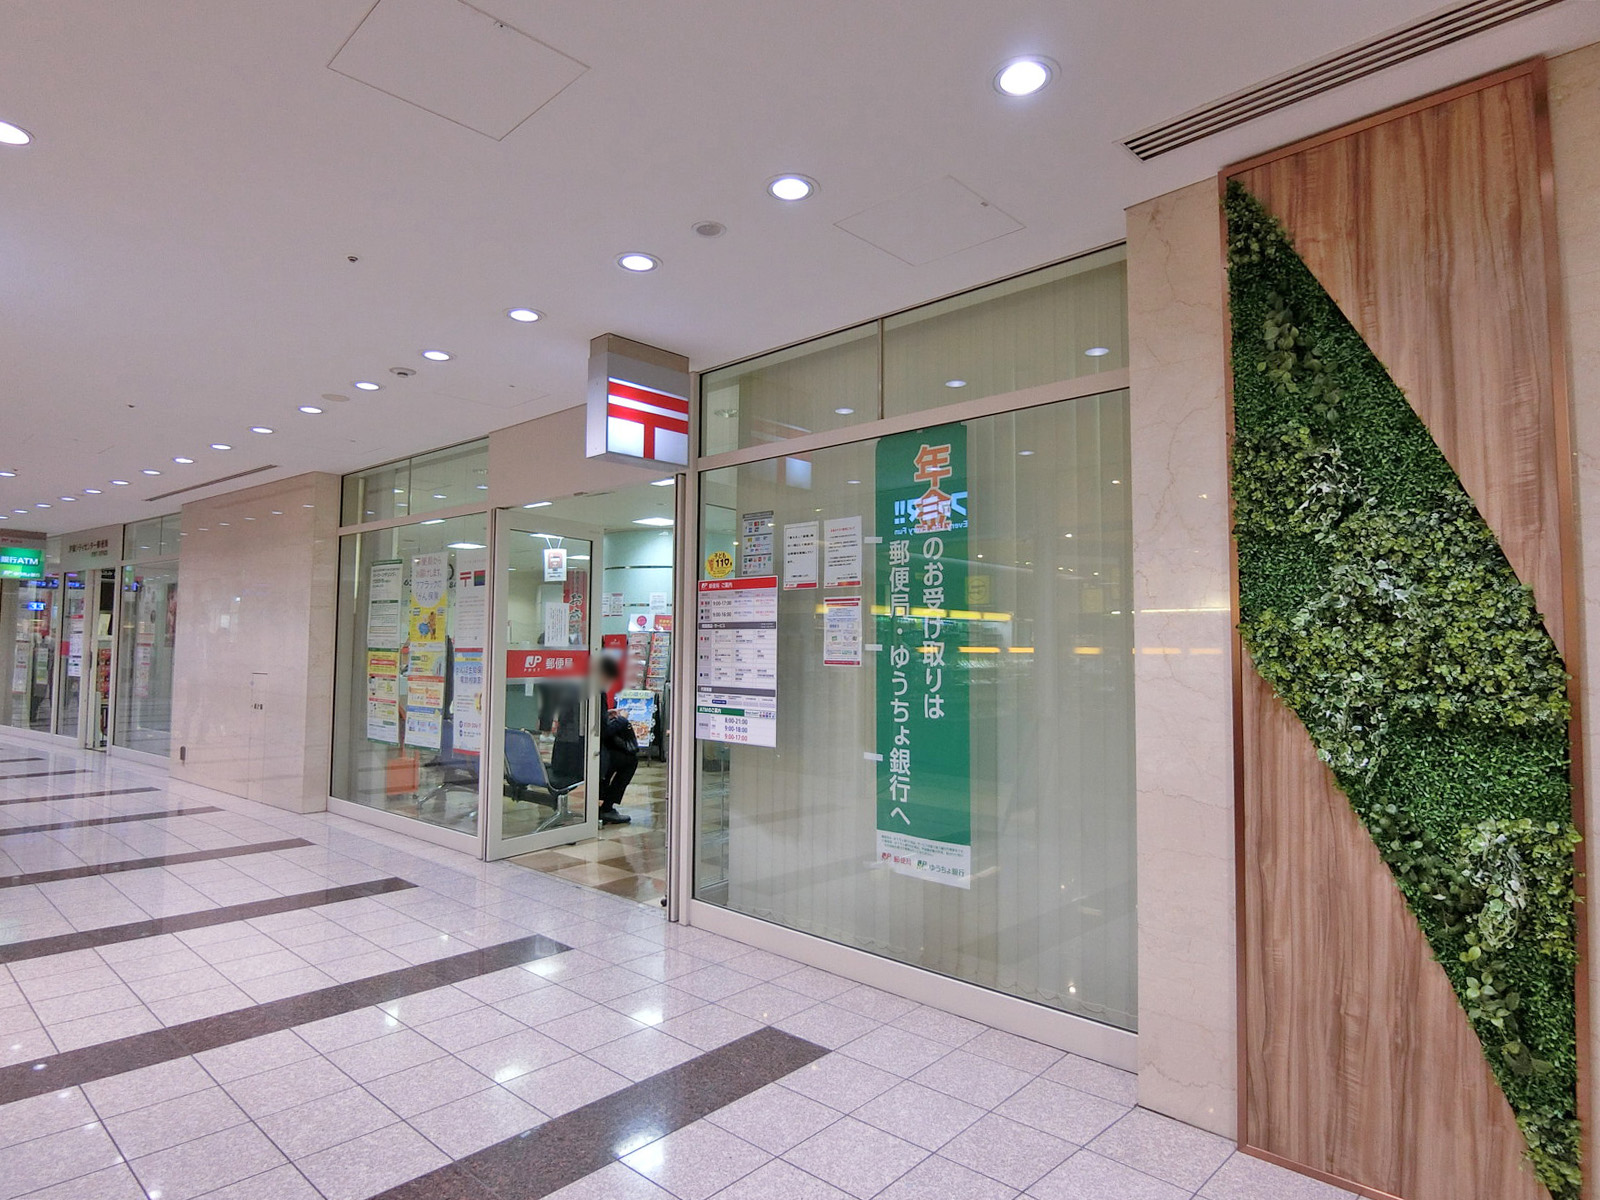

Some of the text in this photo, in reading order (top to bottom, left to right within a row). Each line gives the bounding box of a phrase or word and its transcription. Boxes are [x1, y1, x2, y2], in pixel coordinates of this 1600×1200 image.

[888, 539, 911, 828] 郵便局・ゆうちょ銀行へ
[914, 444, 952, 720] 年金のお受け取りは
[929, 865, 965, 877] ゆうちょ銀行
